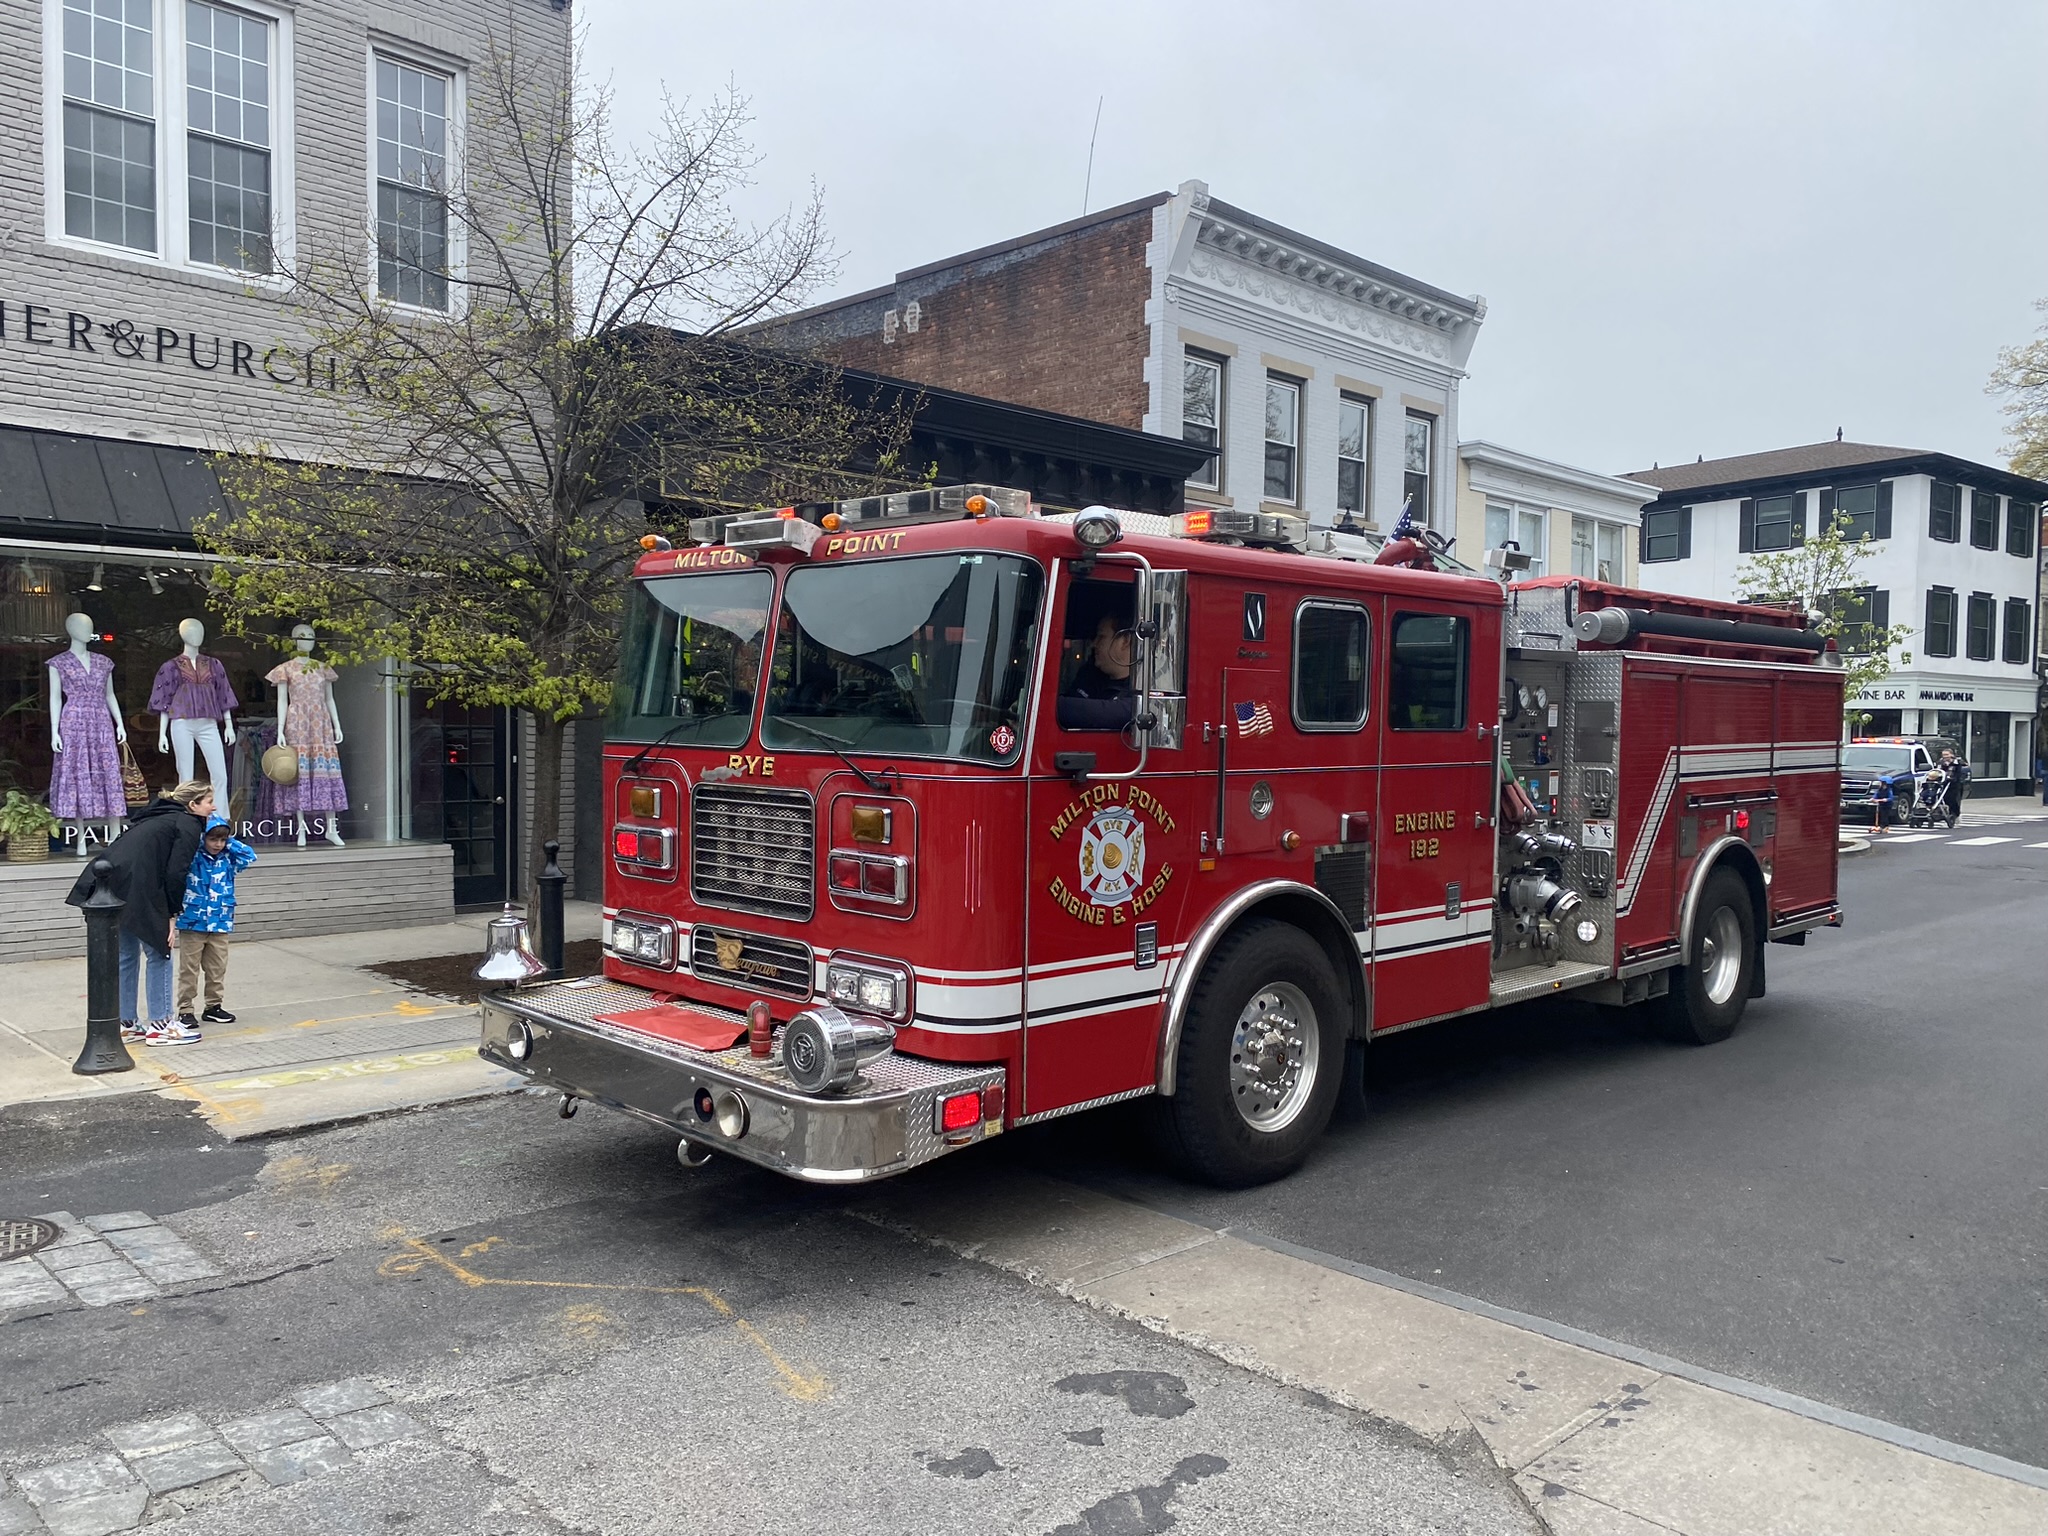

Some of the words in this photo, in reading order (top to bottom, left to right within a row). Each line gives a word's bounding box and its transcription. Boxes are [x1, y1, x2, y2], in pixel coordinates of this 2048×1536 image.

[0, 301, 96, 351] ER
[674, 549, 747, 569] MILTON
[826, 532, 906, 556] POINT
[1884, 690, 1905, 700] BAR
[729, 755, 775, 776] RYE
[1050, 784, 1119, 839] MILTON
[1129, 785, 1176, 834] POINT
[1395, 810, 1456, 833] ENGINE
[1103, 820, 1123, 831] RYE
[1411, 838, 1439, 858] 192
[1048, 876, 1105, 925] ENGINE
[1131, 862, 1174, 916] HOSE
